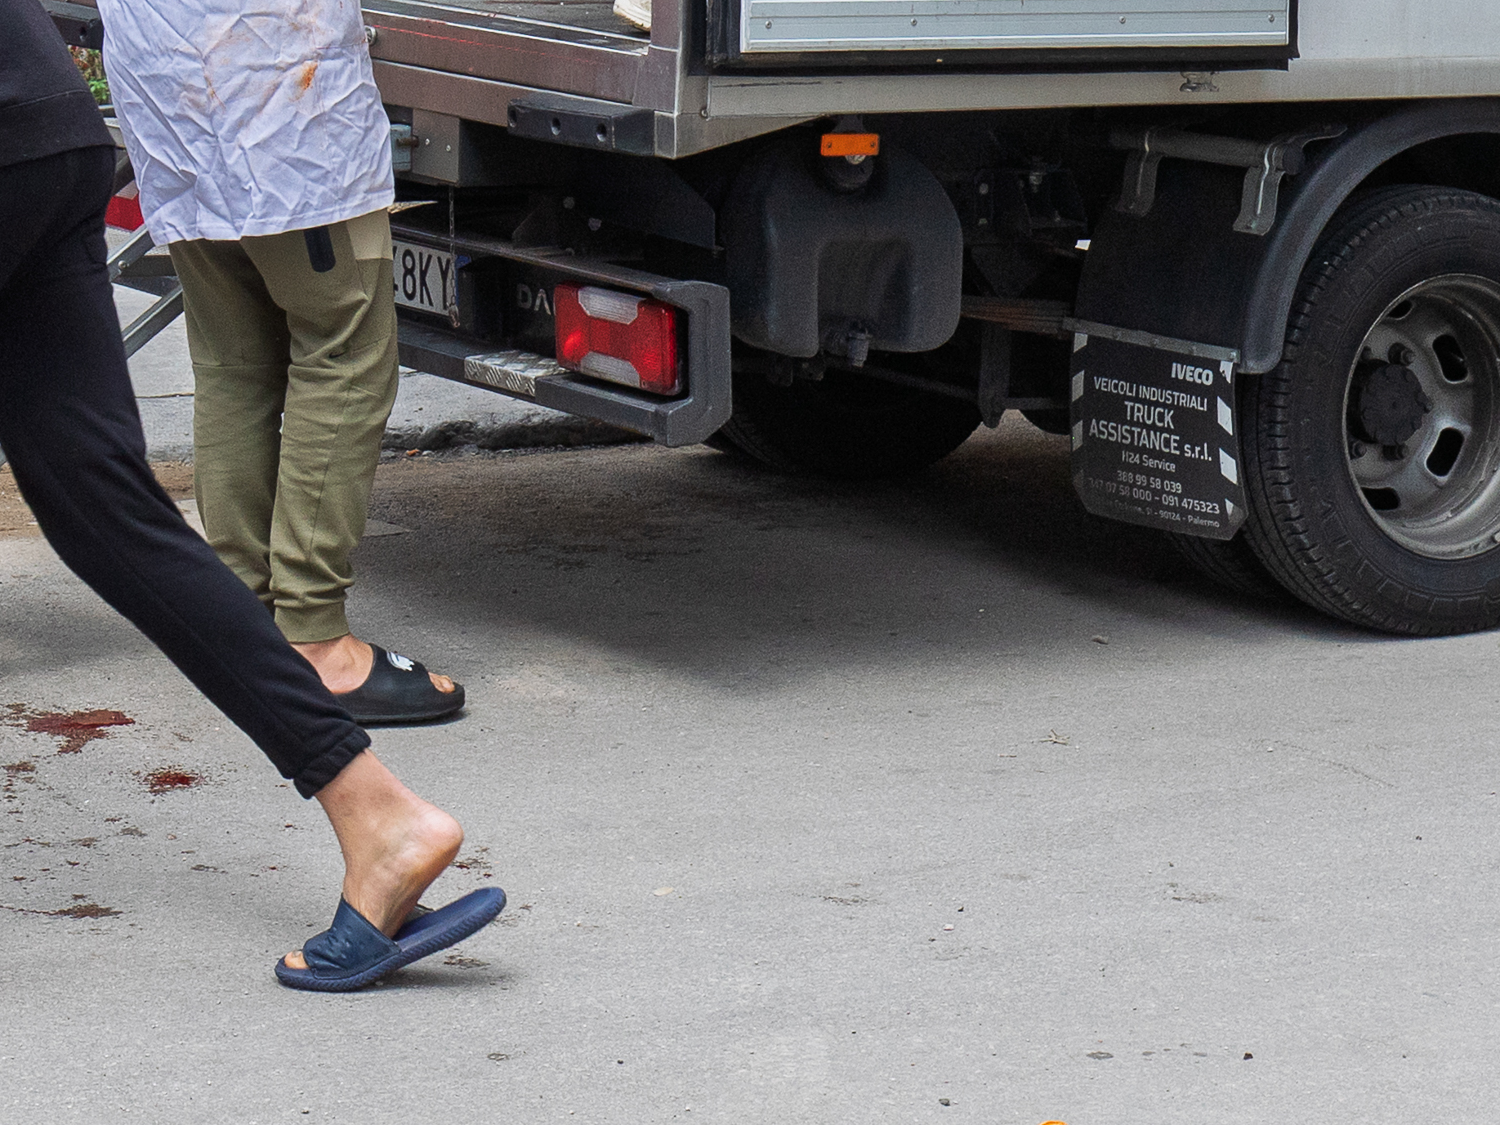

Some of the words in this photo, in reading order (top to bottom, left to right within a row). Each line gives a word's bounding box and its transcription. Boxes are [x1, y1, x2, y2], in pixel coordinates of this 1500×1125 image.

[1171, 362, 1214, 386] IVECO
[1093, 376, 1137, 397] VEICOLI
[1138, 384, 1208, 412] INDUSTRIALI
[1124, 400, 1175, 430] TRUCK
[1089, 418, 1180, 455] ASSISTANCE
[1184, 442, 1213, 462] s.r.l.
[1121, 450, 1141, 465] H24
[1142, 456, 1177, 473] Service
[1135, 475, 1148, 486] 99
[1150, 477, 1162, 489] 58
[1164, 480, 1182, 494] 039
[1132, 488, 1153, 502] 000
[1161, 494, 1180, 508] 091
[1181, 499, 1221, 515] 475323
[1188, 515, 1221, 529] Palermo
